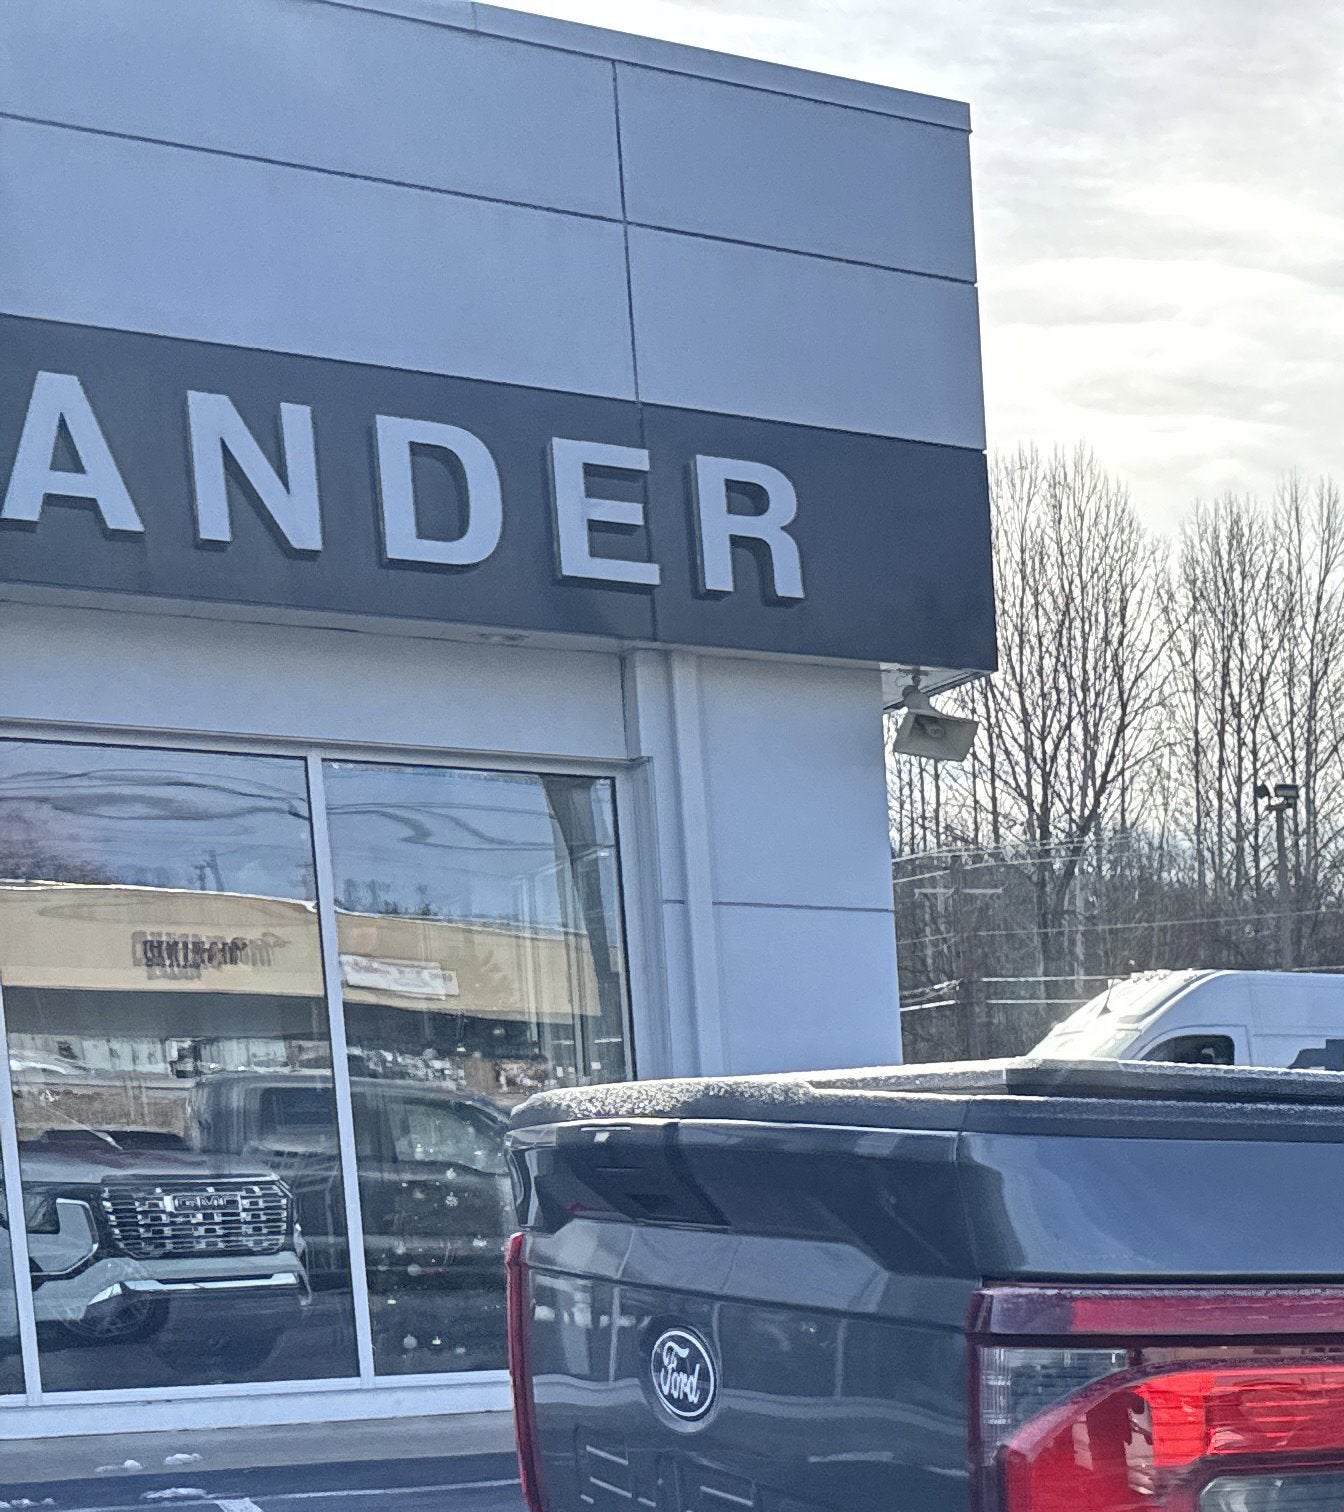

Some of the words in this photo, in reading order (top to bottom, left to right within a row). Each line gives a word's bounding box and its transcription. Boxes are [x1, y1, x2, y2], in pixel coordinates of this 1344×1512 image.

[0, 370, 805, 599] ANDER
[173, 1193, 239, 1209] GMC
[659, 1339, 701, 1405] Ford
